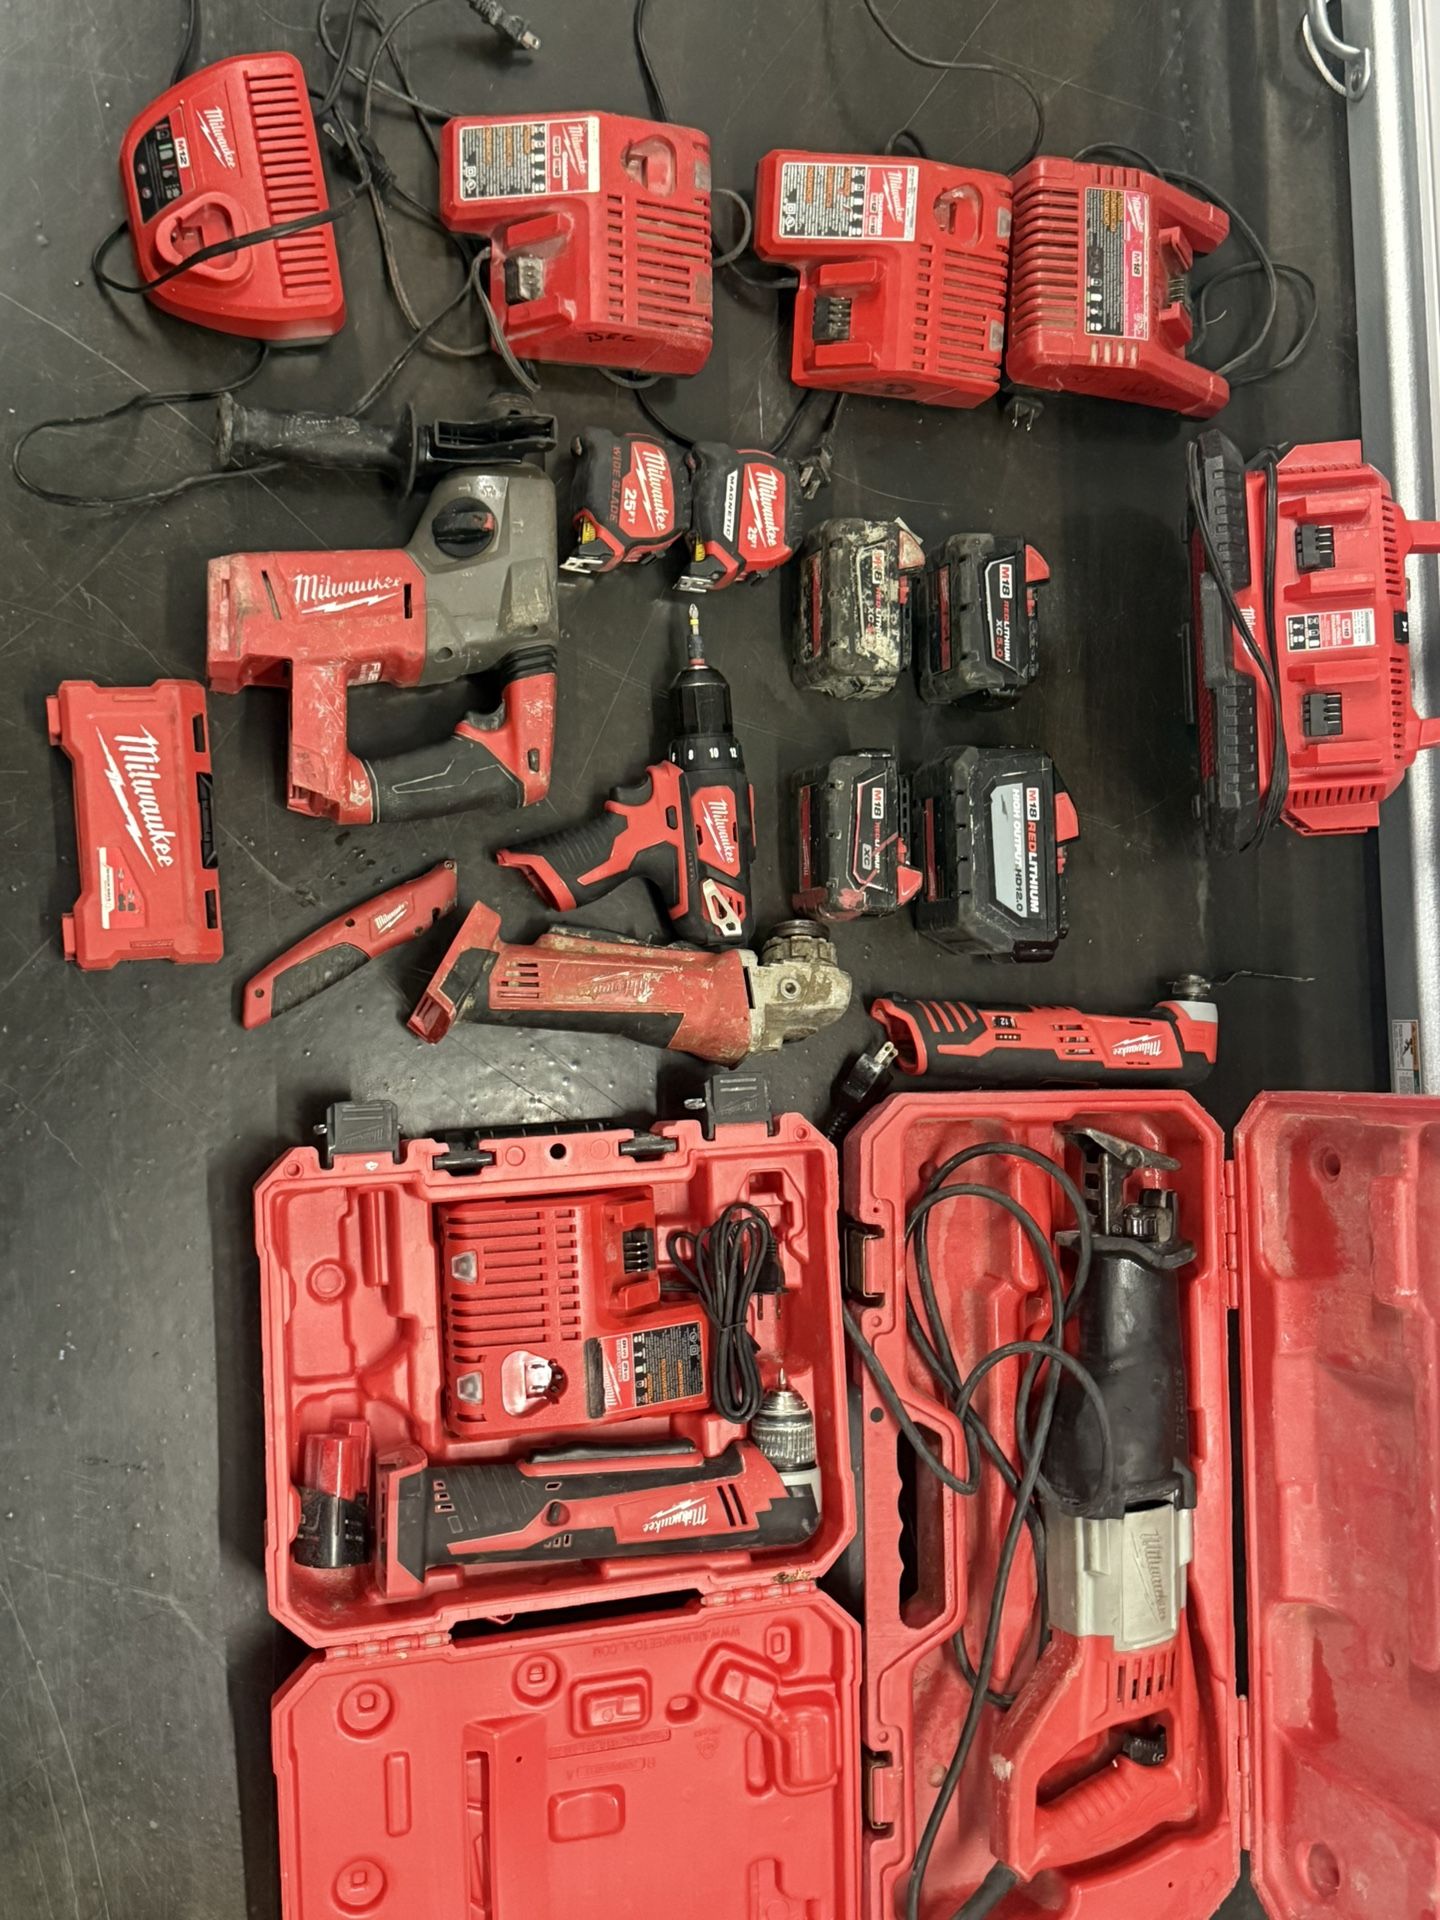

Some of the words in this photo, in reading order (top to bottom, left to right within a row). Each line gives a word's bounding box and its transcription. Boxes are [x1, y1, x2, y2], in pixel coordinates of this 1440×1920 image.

[176, 139, 189, 166] M12
[203, 105, 236, 169] Milwaukee
[568, 123, 587, 174] Milwaukee
[888, 170, 904, 223] Milwaukee
[612, 447, 622, 478] WIDE
[609, 480, 620, 523] BLADE
[624, 488, 637, 524] 25FT
[643, 450, 669, 531] Milwaukee
[726, 476, 735, 536] MAGNETIC
[755, 470, 779, 547] Milwaukee
[292, 573, 402, 606] Milwaukee
[1001, 566, 1010, 596] M18
[688, 749, 695, 761] 8
[709, 747, 719, 759] 10
[729, 747, 738, 758] 12
[113, 724, 176, 868] Milwaukee
[1012, 788, 1021, 818] HIGH
[1028, 789, 1037, 818] M18
[708, 798, 735, 864] Milwaukee
[1014, 820, 1023, 867] OUTPUT
[864, 848, 870, 866] XC
[1028, 821, 1039, 913] REDLITHIUM
[1015, 869, 1023, 912] HD12.0
[374, 901, 409, 930] Milwaukee
[1000, 1017, 1008, 1025] 12
[1111, 1039, 1163, 1058] Milwaukee
[642, 1503, 710, 1535] Milwaukee
[1140, 1529, 1168, 1621] Milwaukee
